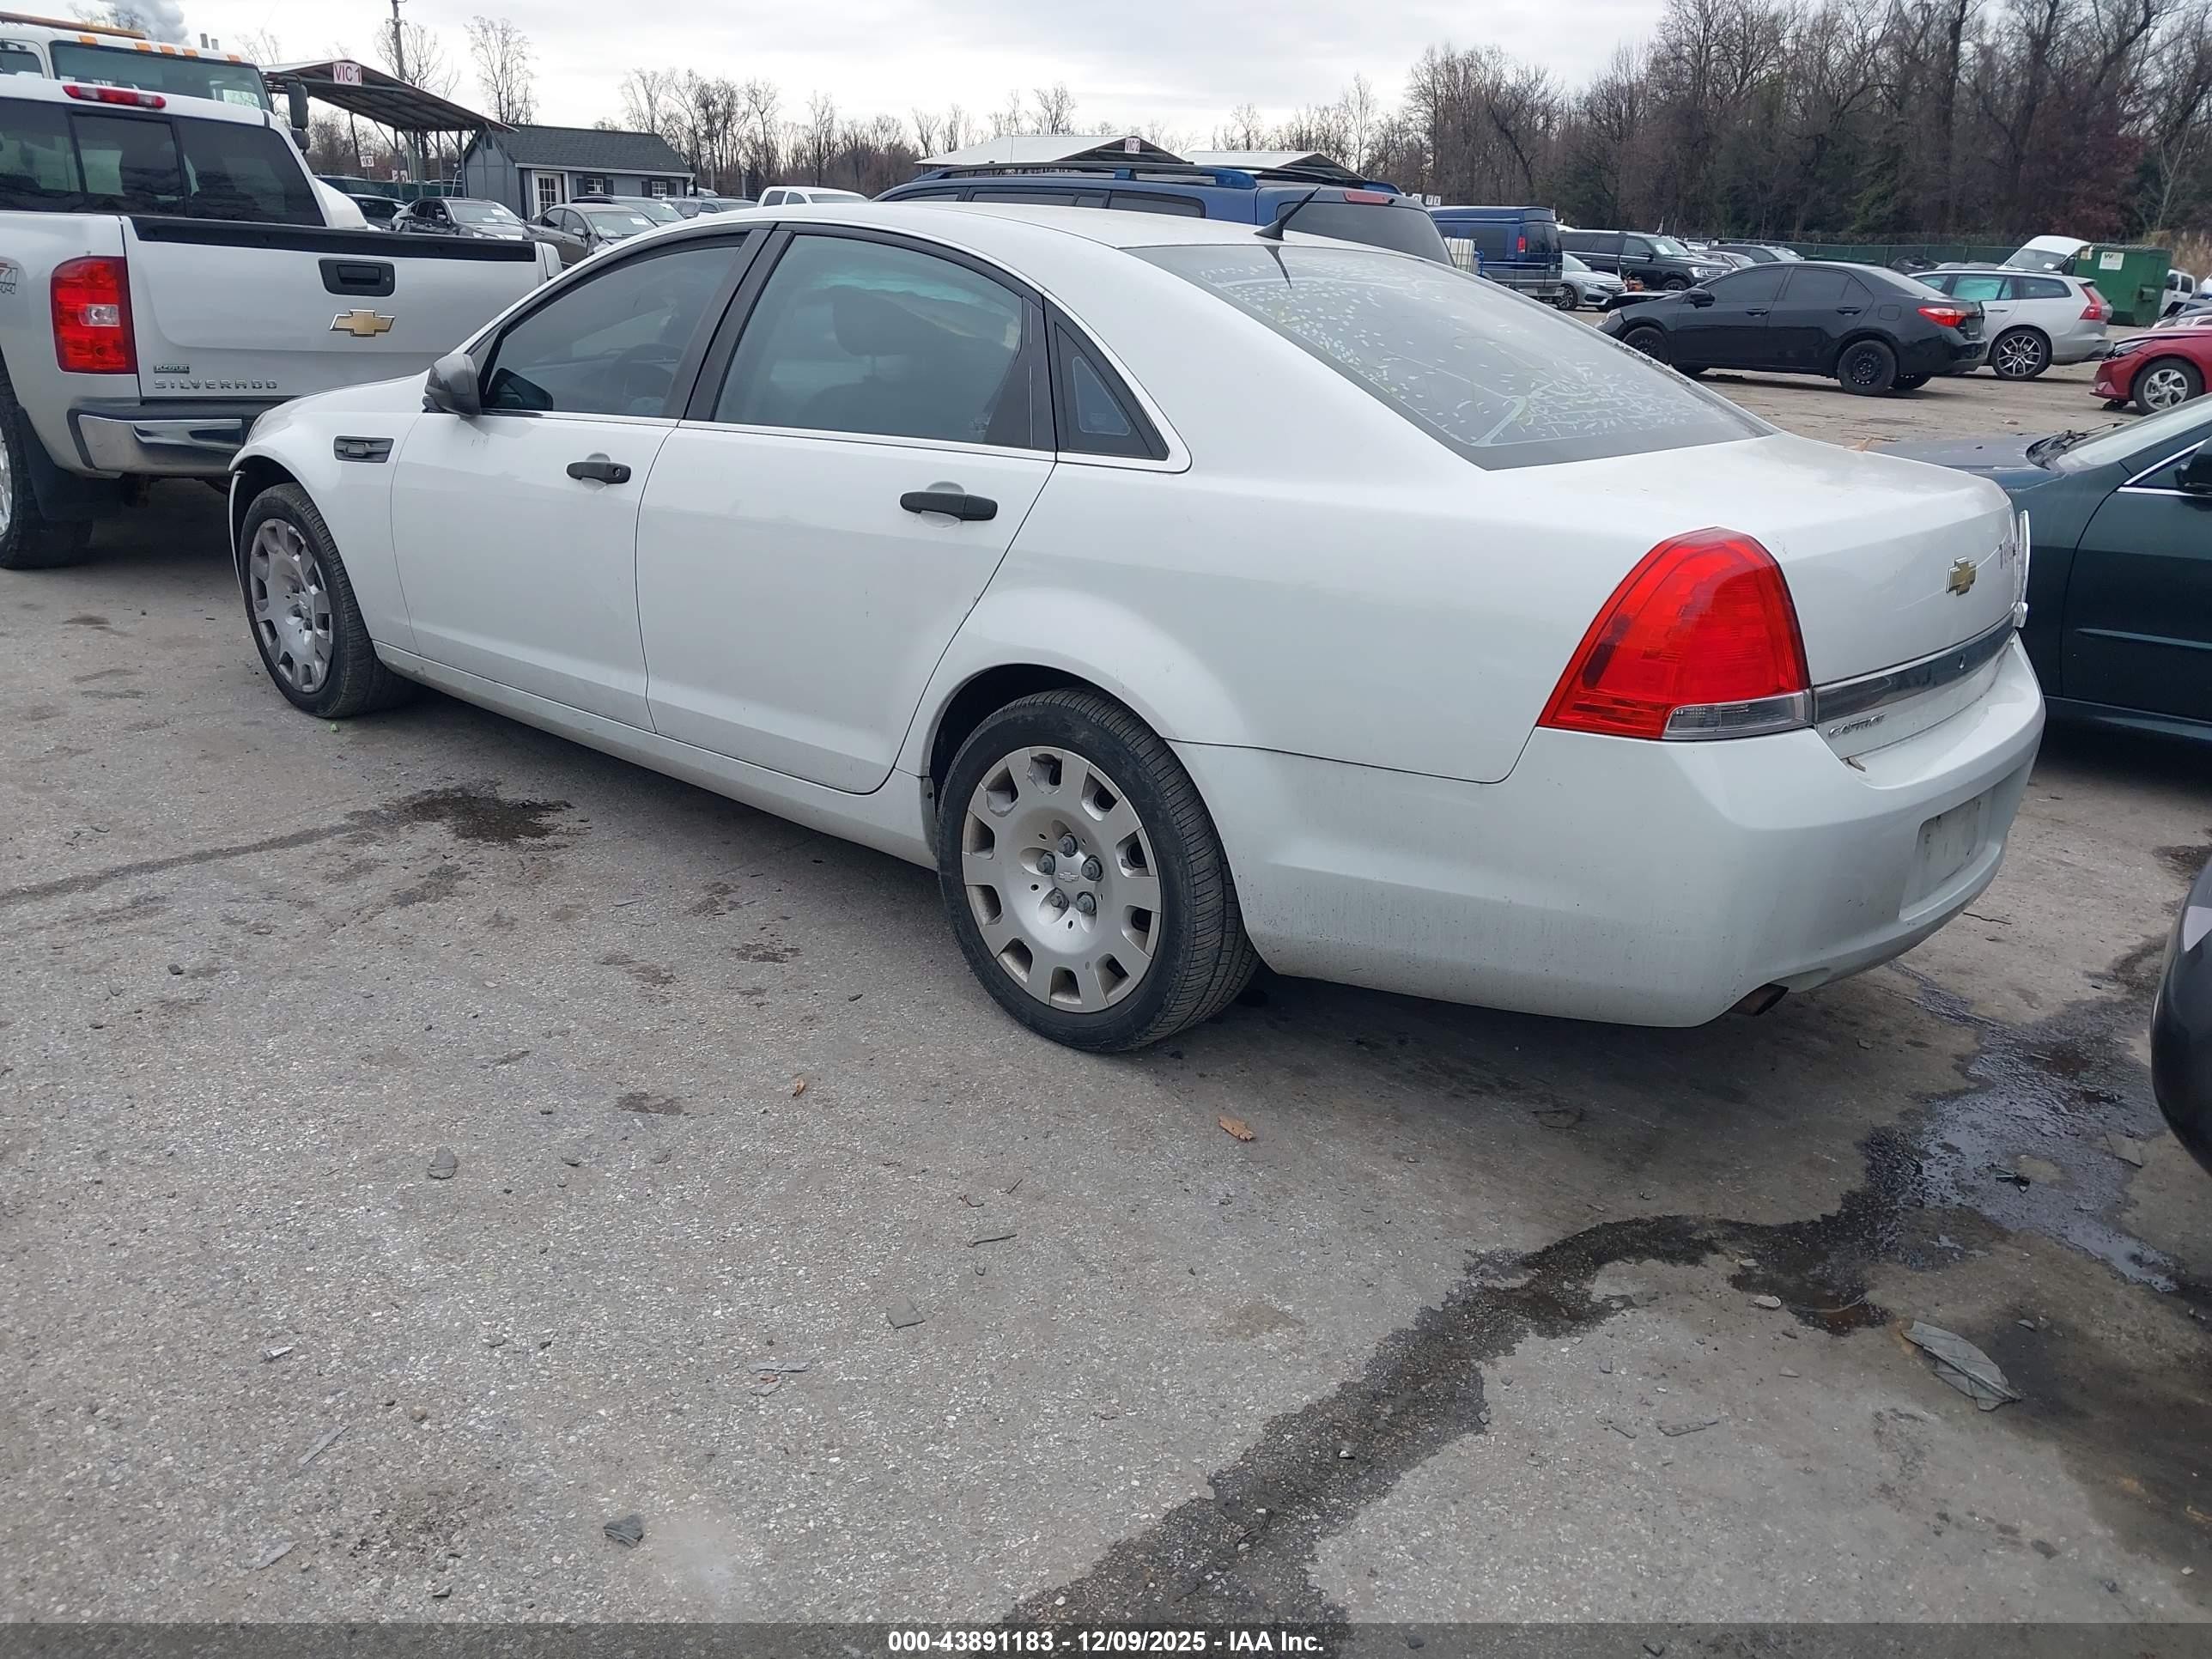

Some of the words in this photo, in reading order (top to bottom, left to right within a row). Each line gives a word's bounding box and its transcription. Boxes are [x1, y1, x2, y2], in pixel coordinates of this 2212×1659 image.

[335, 65, 353, 82] VIC
[356, 67, 361, 83] 1
[154, 379, 278, 390] SILVERADO
